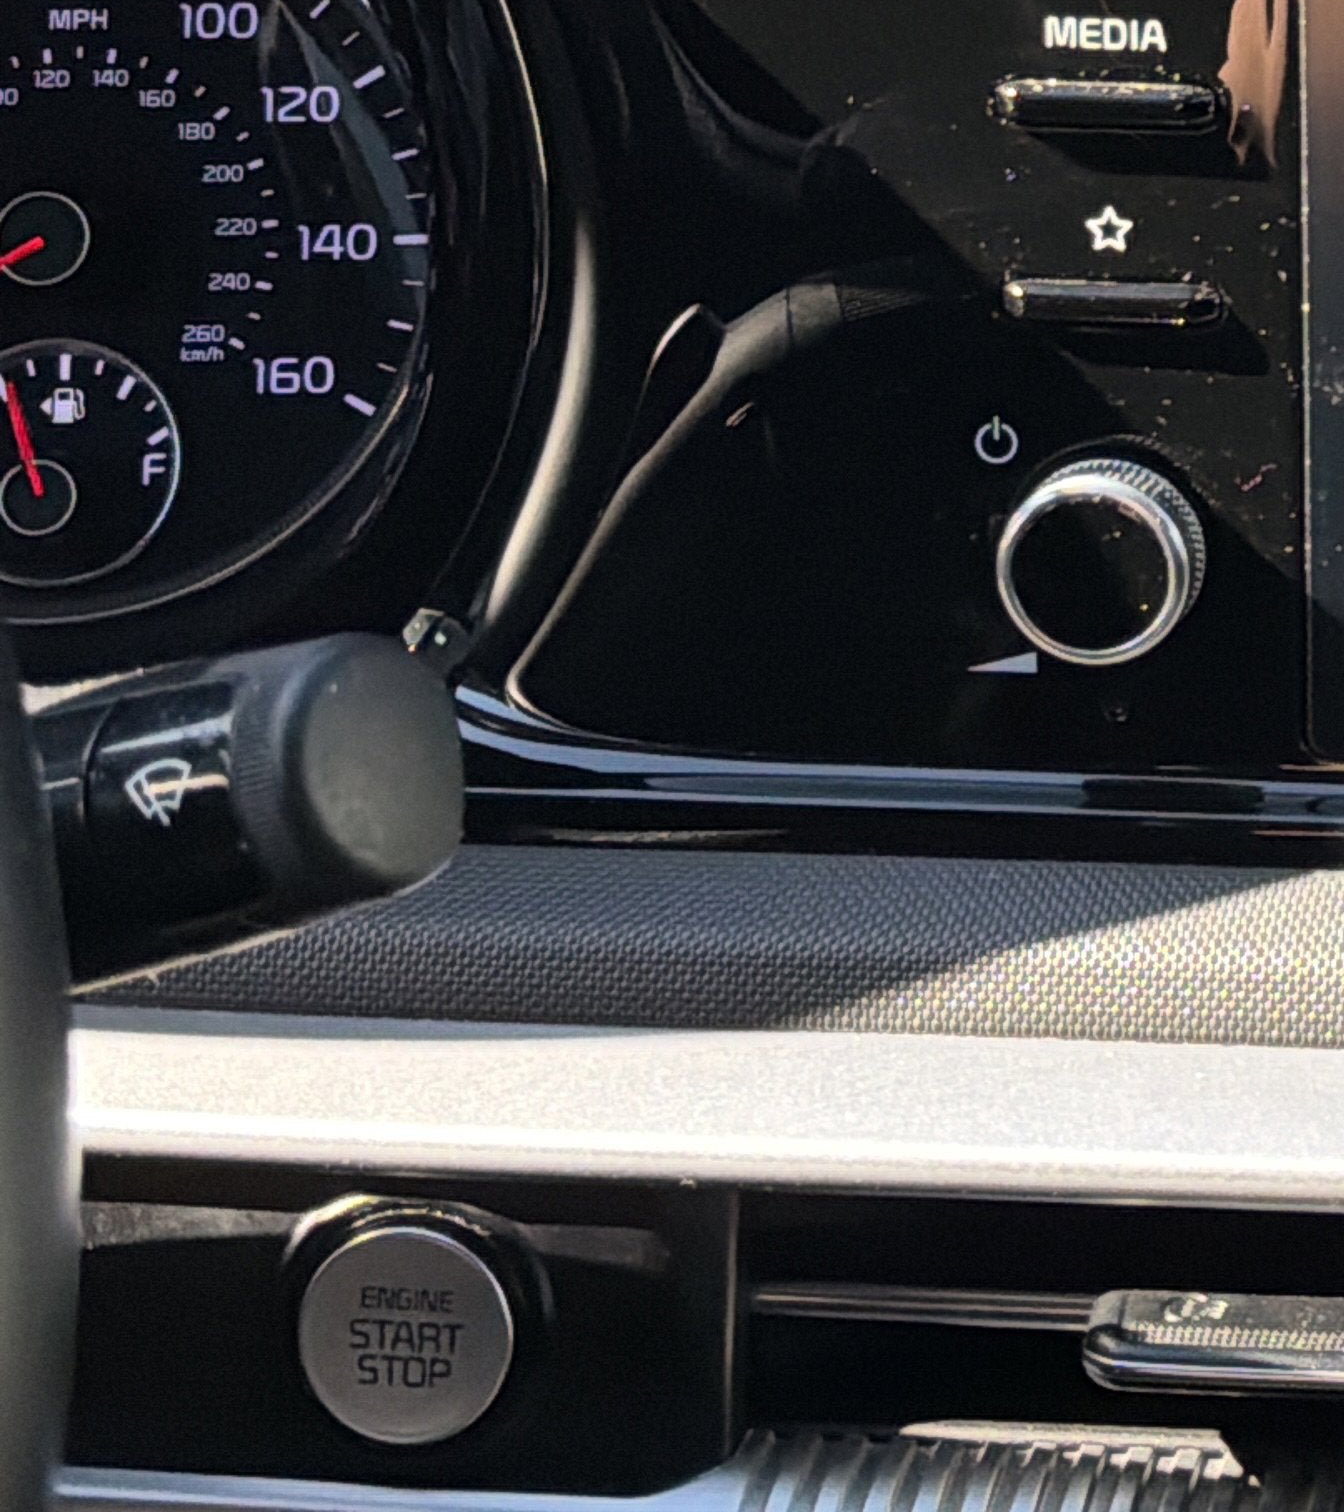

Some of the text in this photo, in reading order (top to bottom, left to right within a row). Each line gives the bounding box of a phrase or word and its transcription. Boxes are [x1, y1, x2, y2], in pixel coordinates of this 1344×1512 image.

[49, 9, 108, 29] MPH
[180, 3, 258, 38] 100
[1044, 16, 1167, 52] MEDIA
[34, 70, 70, 88] 120
[93, 69, 129, 86] 140
[139, 90, 175, 107] 160
[262, 86, 340, 122] 120
[179, 122, 215, 140] 180
[202, 165, 243, 182] 200
[215, 218, 257, 235] 220
[298, 224, 377, 260] 140
[209, 273, 250, 290] 240
[182, 325, 225, 342] 260
[180, 346, 224, 361] km/h
[253, 356, 334, 393] 160
[143, 453, 166, 485] F
[360, 1287, 454, 1314] ENGINE
[349, 1320, 464, 1355] START
[357, 1355, 453, 1389] STOP
